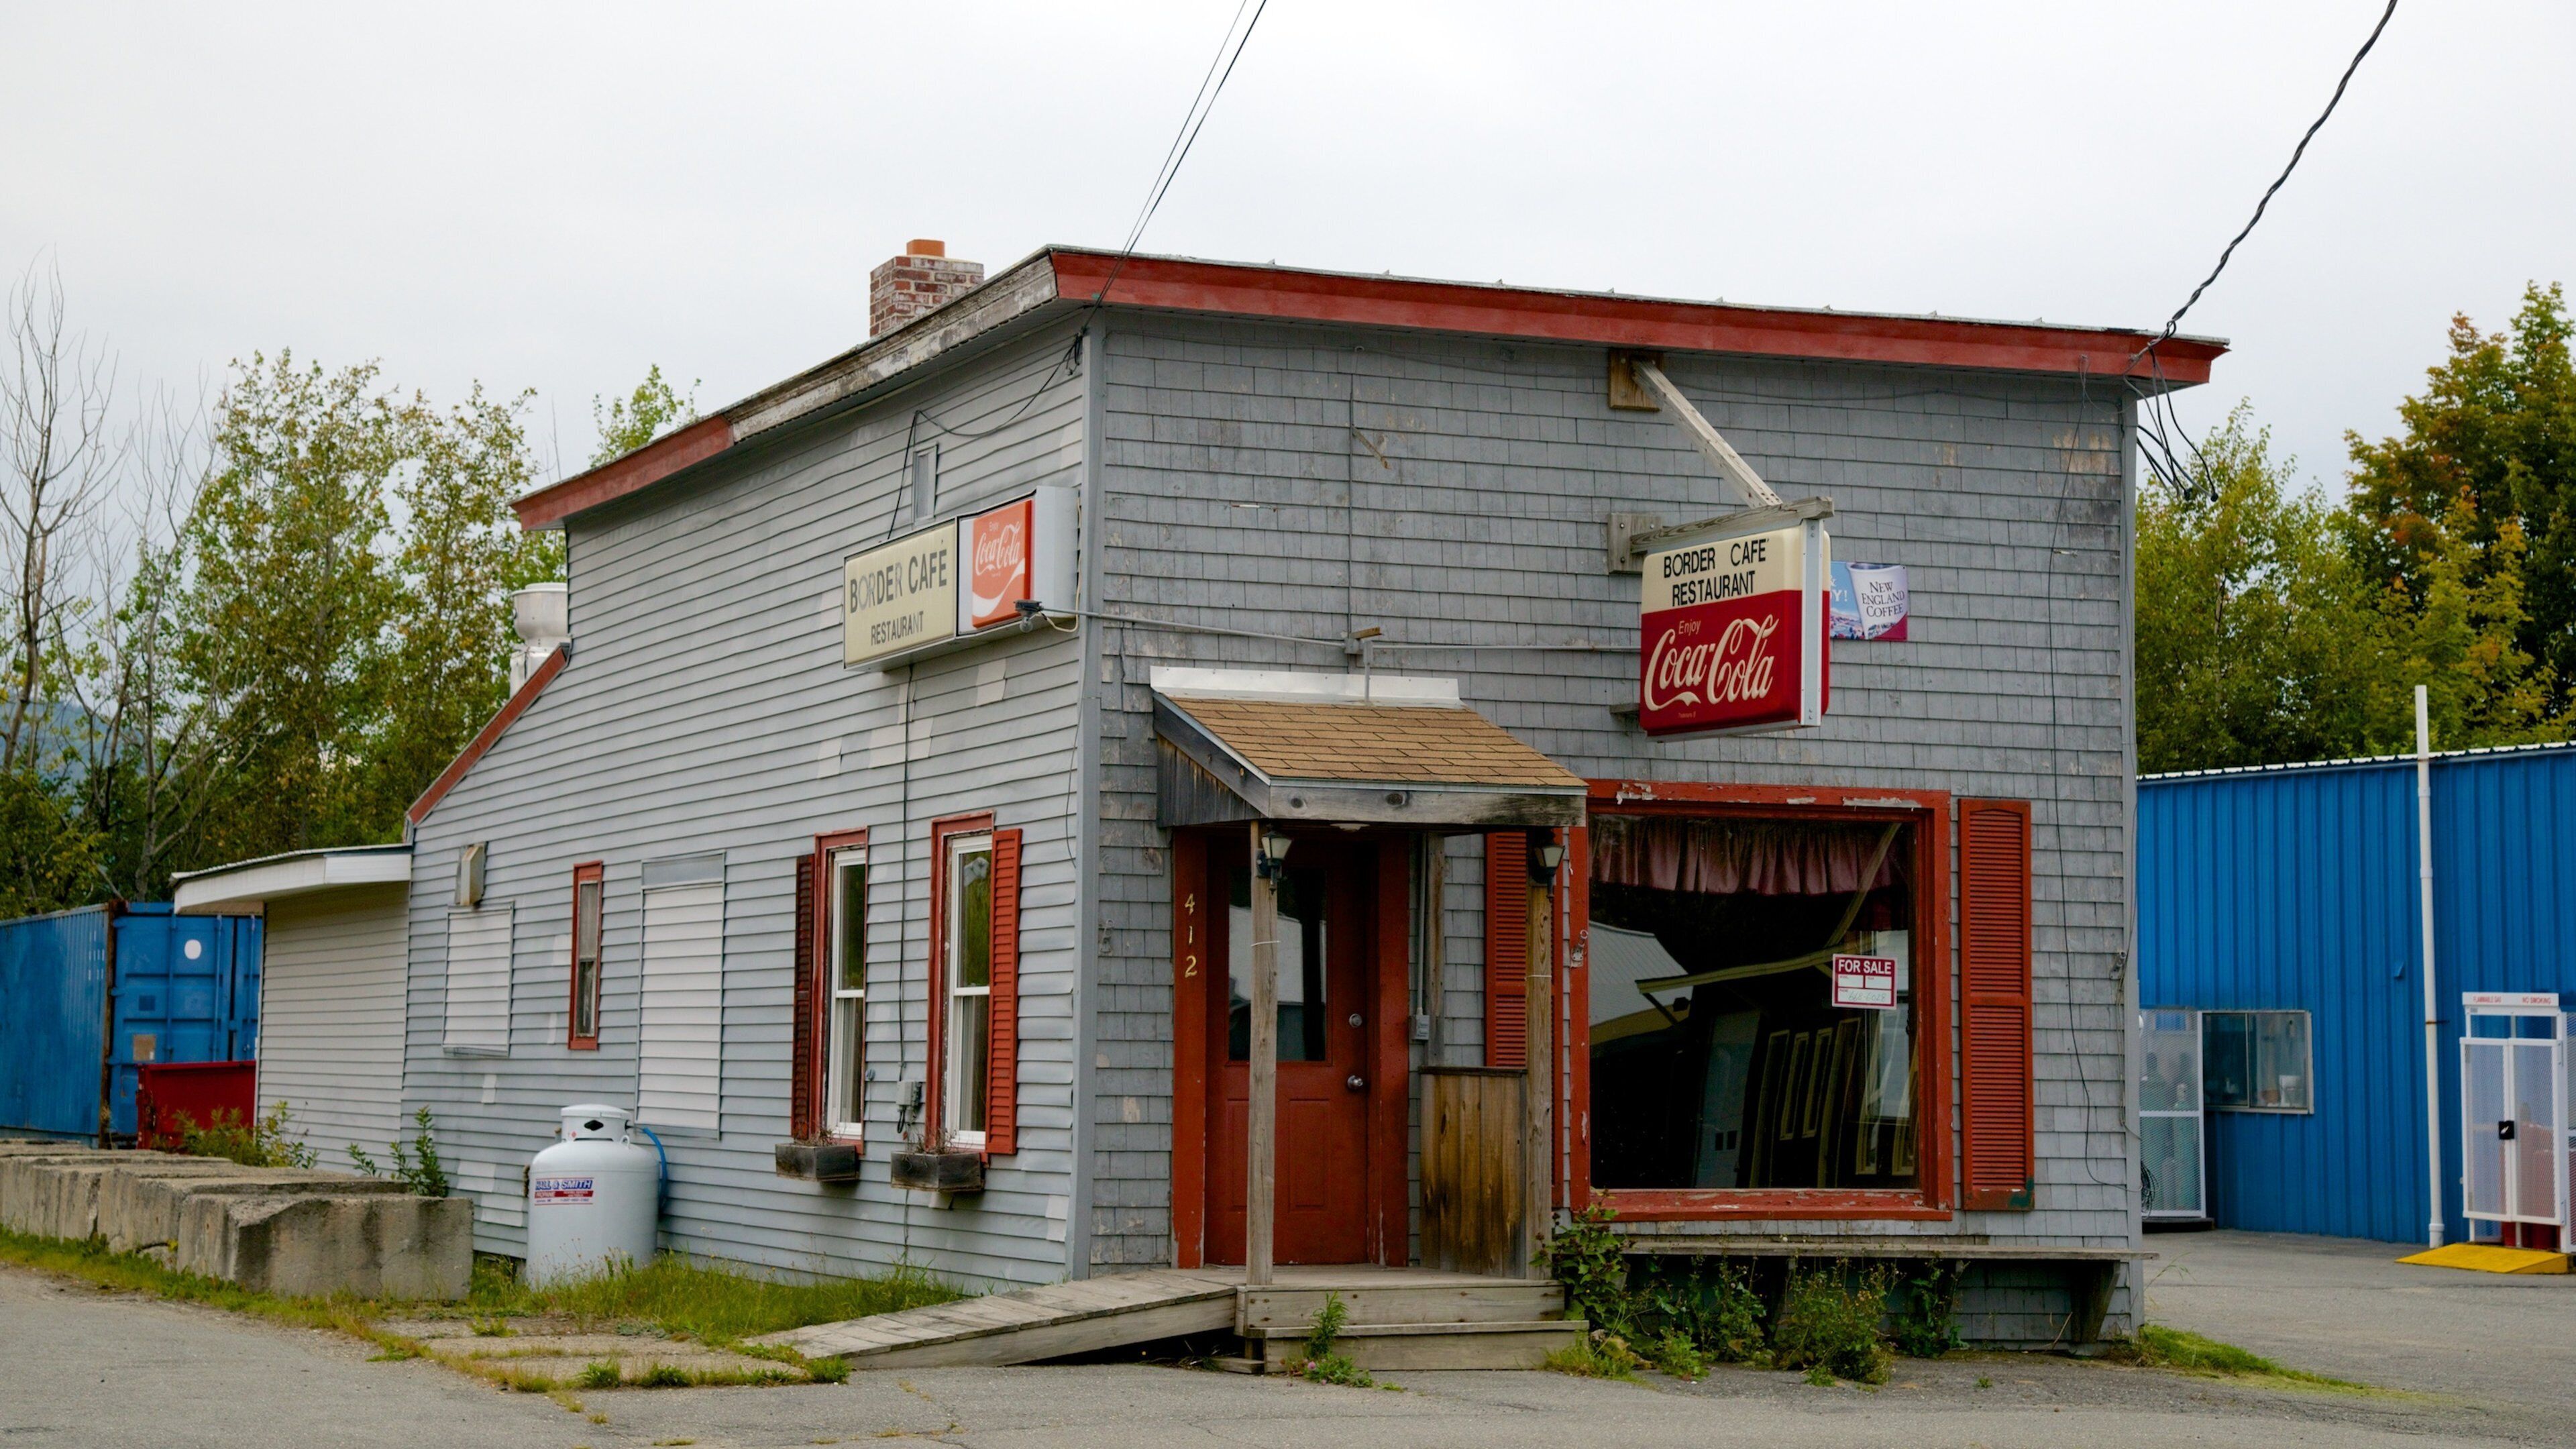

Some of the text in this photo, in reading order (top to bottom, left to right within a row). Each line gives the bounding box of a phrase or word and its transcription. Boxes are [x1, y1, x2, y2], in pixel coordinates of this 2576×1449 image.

[975, 521, 1022, 576] Coca-Cola
[1664, 547, 1715, 578] BORDER
[850, 561, 903, 614] BORDER
[1672, 570, 1756, 607] RESTAURANT
[1862, 590, 1905, 605] ENGLAND
[1869, 581, 1893, 594] NEW
[1866, 603, 1904, 617] COFFEE
[871, 610, 924, 646] RESTAURANT
[1678, 619, 1702, 637] Enjoy
[1644, 614, 1780, 712] Coca-Cola
[1838, 959, 1892, 975] FOR SALE
[561, 1179, 593, 1189] SMITH
